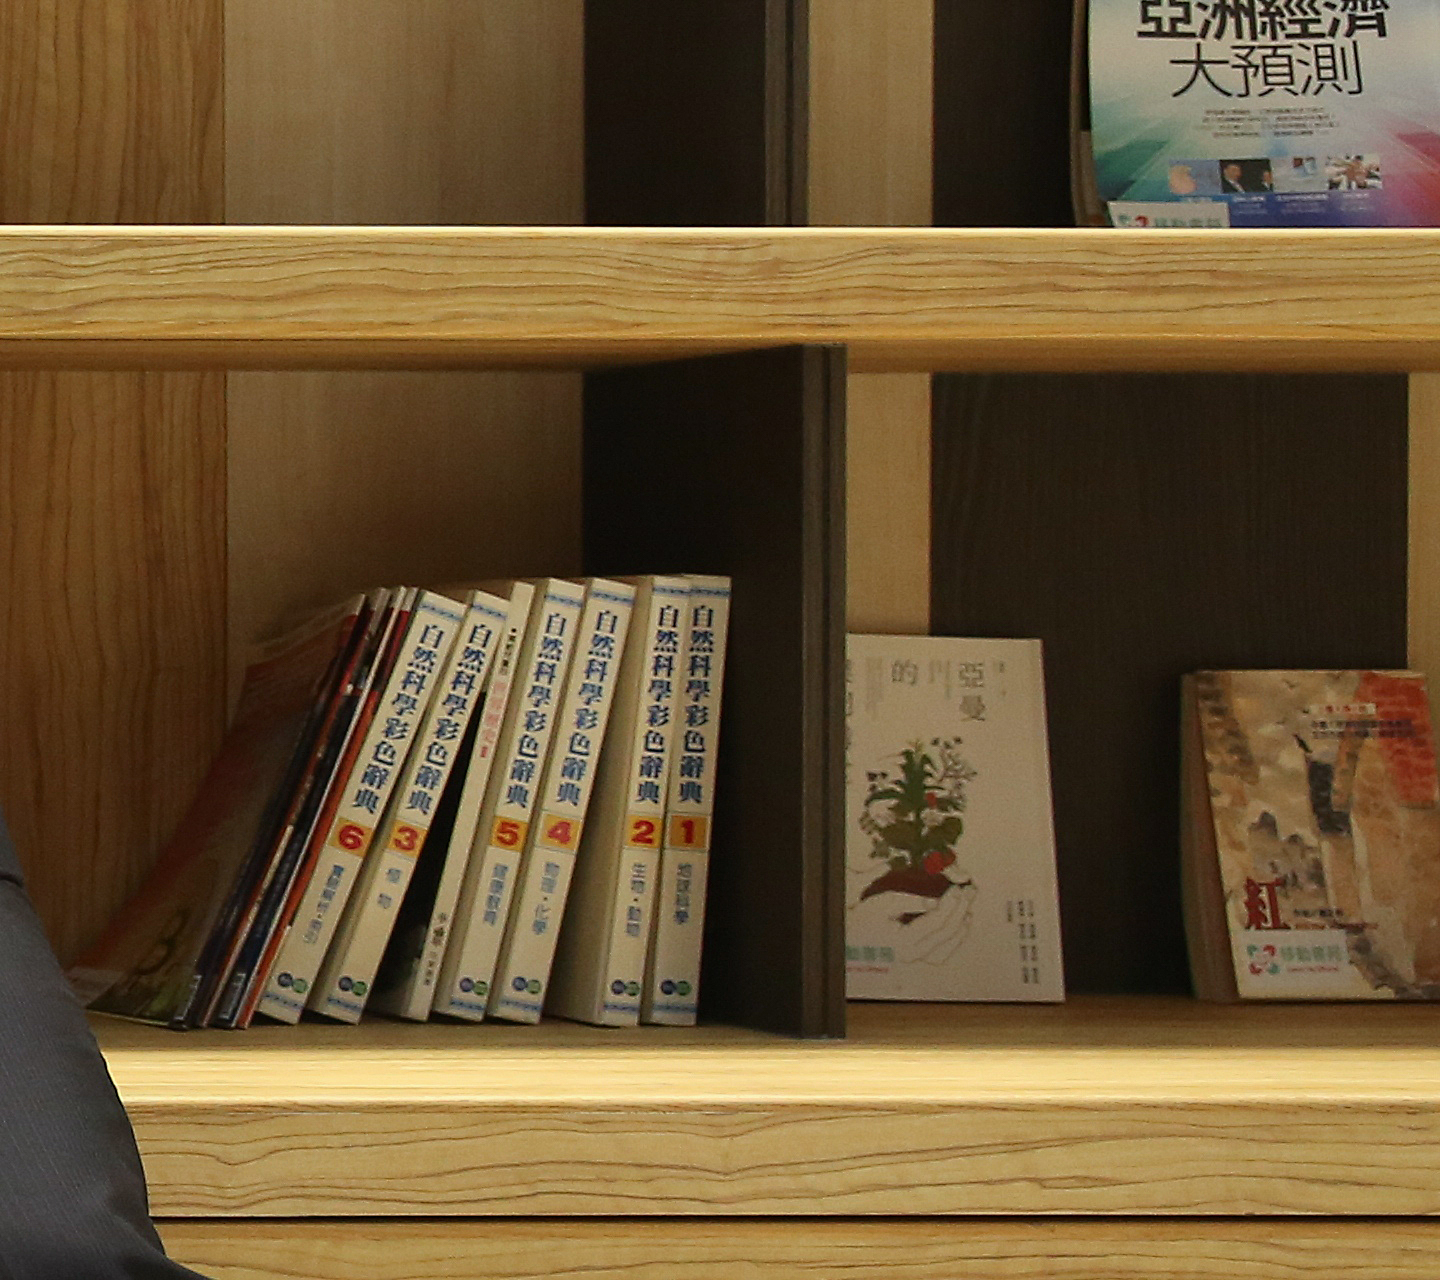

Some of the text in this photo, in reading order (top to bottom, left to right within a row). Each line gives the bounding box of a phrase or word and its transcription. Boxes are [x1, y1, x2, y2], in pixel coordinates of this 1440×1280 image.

[1170, 40, 1363, 98] 大預測
[353, 624, 439, 815] 自然科學彩色辭典
[408, 623, 492, 815] 自然科學彩色辭典
[506, 611, 566, 810] 自然科學彩色辭典
[556, 609, 619, 807] 自然科學彩色辭典
[636, 603, 679, 805] 自然科學彩色辭典
[679, 603, 714, 804] 自然科學彩色辭典
[338, 827, 364, 851] 6
[394, 825, 418, 850] 3
[495, 821, 518, 846] 5
[547, 820, 571, 844] 4
[631, 820, 654, 844] 2
[681, 820, 695, 844] 1
